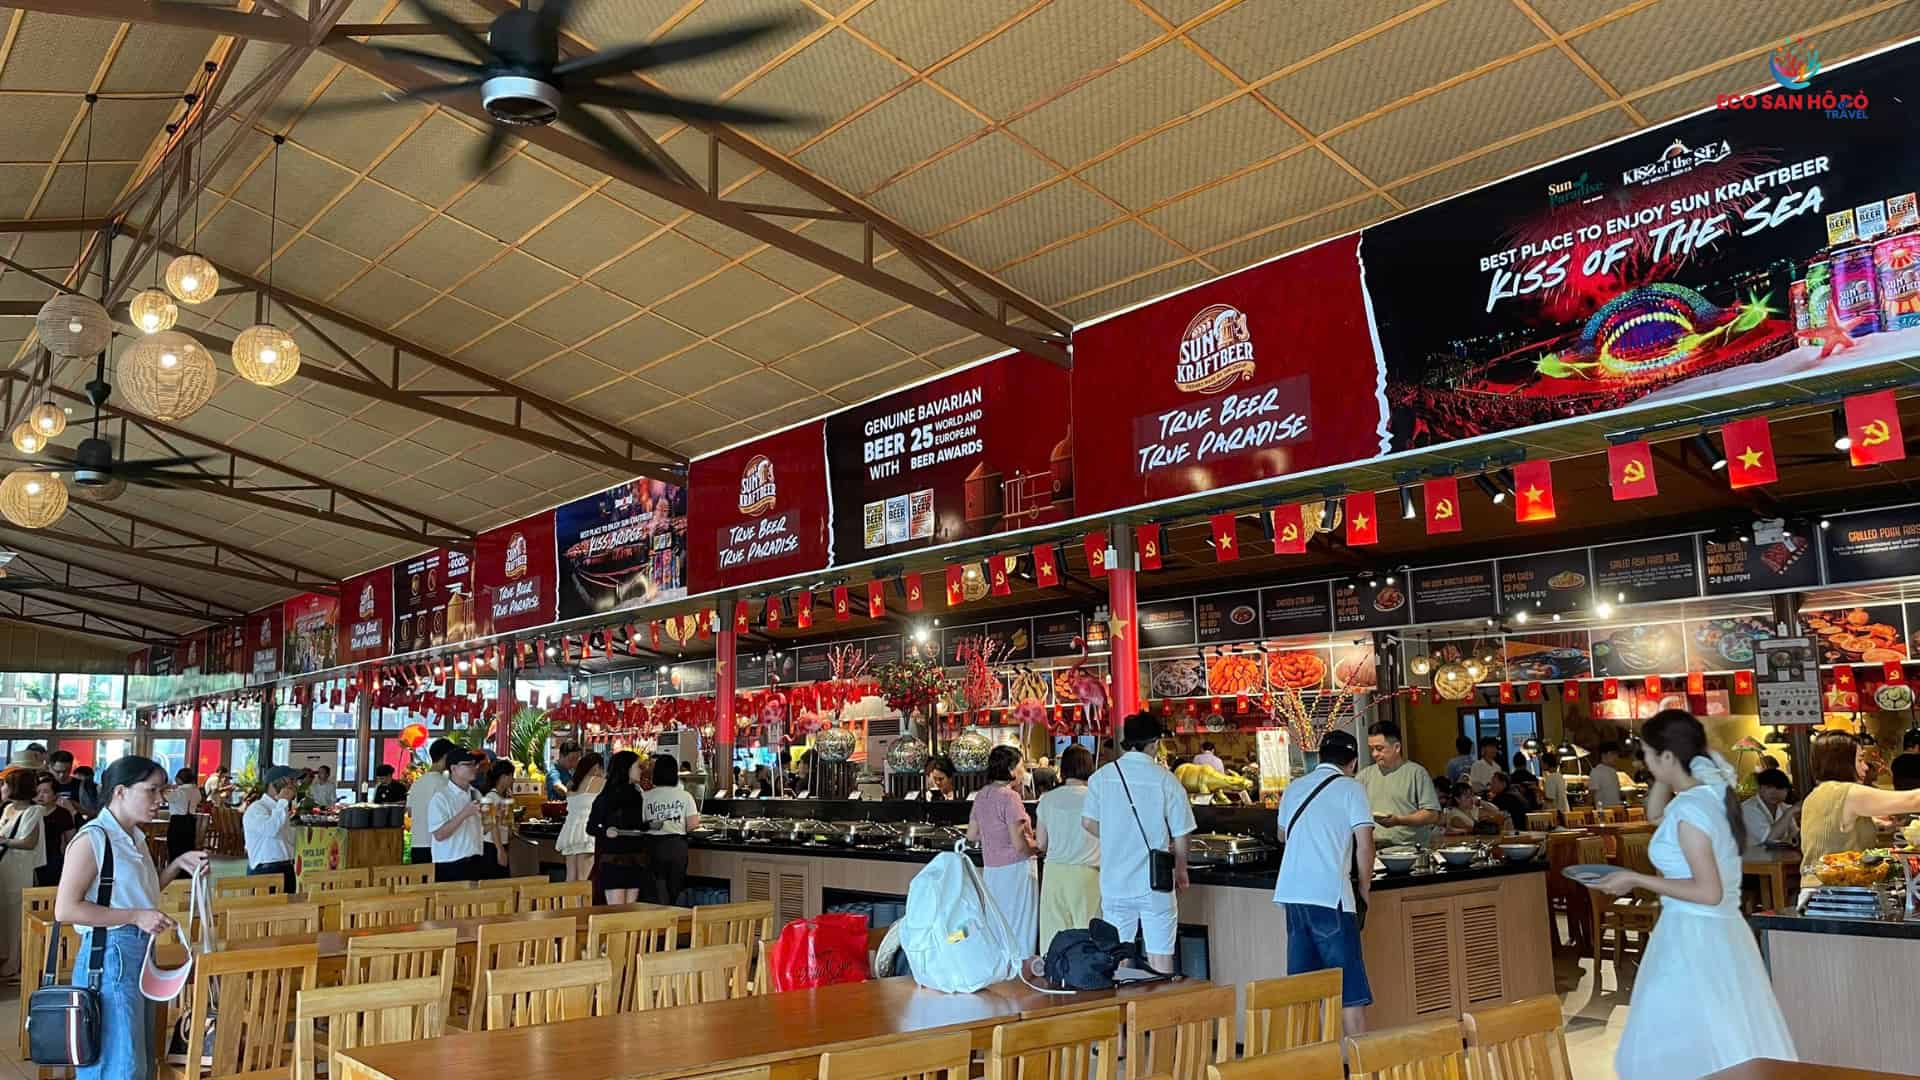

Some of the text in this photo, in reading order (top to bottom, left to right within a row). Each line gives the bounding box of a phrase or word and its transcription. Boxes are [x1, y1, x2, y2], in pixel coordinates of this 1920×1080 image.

[1657, 159, 1671, 175] of
[1673, 154, 1693, 171] the
[1547, 179, 1573, 197] Sun
[1480, 250, 1518, 272] BEST
[1521, 233, 1574, 262] PLACE
[1577, 224, 1602, 246] TO
[1606, 204, 1665, 240] ENJOY
[1671, 191, 1714, 217] SUN
[1716, 156, 1830, 204] KRAFTBEER
[1860, 209, 1881, 220] BEER
[1889, 202, 1914, 215] BEER
[1828, 217, 1850, 230] BEER
[1485, 185, 1825, 313] KISS OF THE SEA
[1180, 329, 1216, 364] SUN
[1177, 341, 1254, 383] KRAFTBEER
[864, 386, 983, 437] GENUINE BAVARIAN
[934, 408, 983, 431] WORLD AND
[1159, 387, 1280, 440] TRUE BEER
[863, 424, 934, 464] BEER 25
[934, 425, 977, 446] EUROPEAN
[1139, 413, 1308, 473] TRUE PARADISE
[869, 438, 984, 481] WITH BEER AWARDS
[739, 483, 777, 507] KRAFTBEER
[741, 472, 759, 494] SUN
[866, 512, 883, 526] BEER
[888, 507, 906, 521] BEER
[911, 502, 931, 516] BEER
[729, 516, 787, 546] TRUE BEER
[719, 535, 799, 569] TRUE PARADISE
